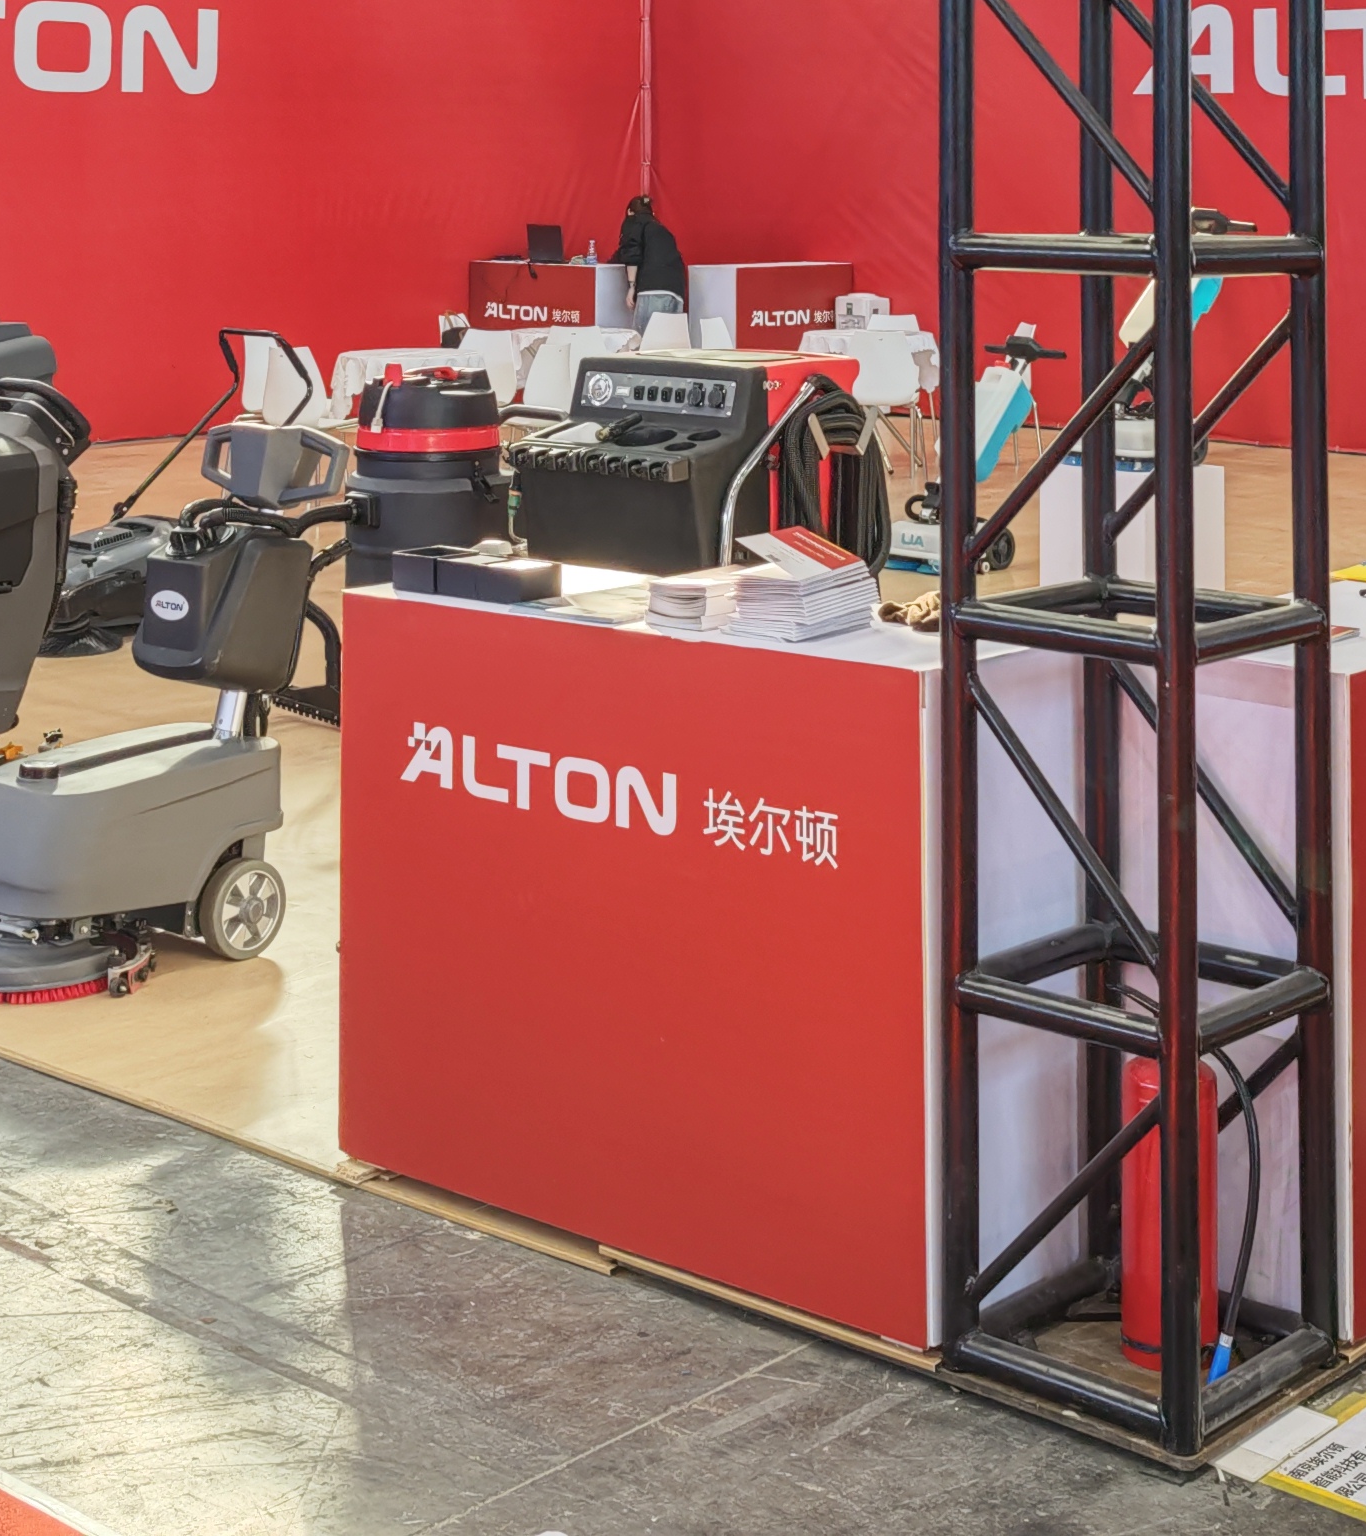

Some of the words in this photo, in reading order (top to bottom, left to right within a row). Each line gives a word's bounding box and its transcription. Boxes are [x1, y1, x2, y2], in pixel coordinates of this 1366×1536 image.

[484, 301, 548, 322] ALTON
[552, 308, 581, 324] 埃尔顿
[750, 309, 810, 327] ALTON
[155, 600, 184, 612] ALTON
[400, 722, 677, 836] ALTON
[703, 789, 840, 869] 埃尔顿
[1287, 1441, 1349, 1480] 南京埃尔顿
